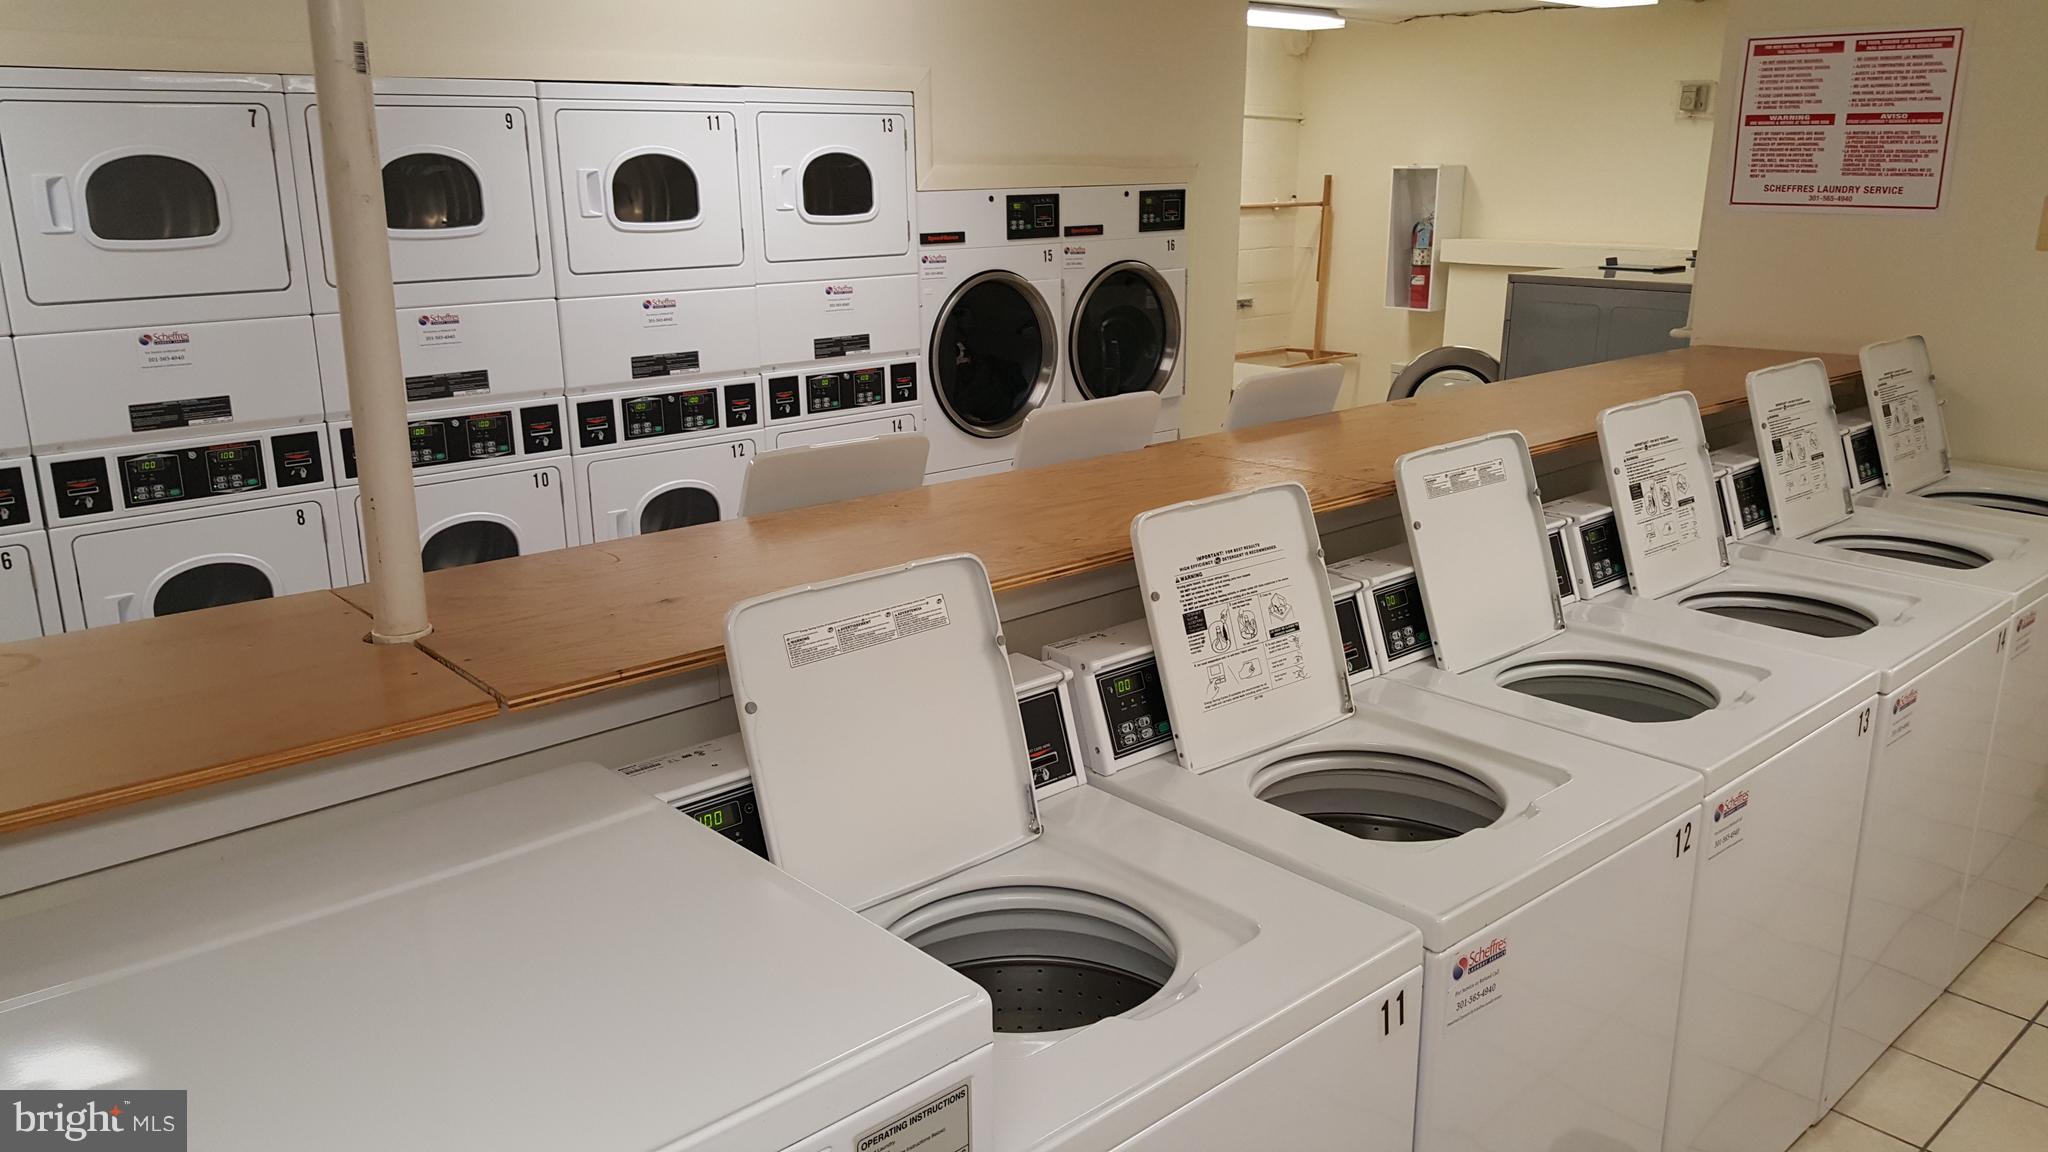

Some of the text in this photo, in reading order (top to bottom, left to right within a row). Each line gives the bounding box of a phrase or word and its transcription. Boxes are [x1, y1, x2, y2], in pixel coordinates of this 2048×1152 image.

[248, 108, 257, 128] 7
[504, 113, 514, 130] 9
[706, 115, 721, 132] 11
[880, 117, 895, 133] 13
[1764, 184, 1814, 192] SCHEFFRES
[1863, 186, 1904, 194] SERVICE
[1166, 240, 1176, 252] 16
[1043, 249, 1053, 263] 15
[891, 419, 903, 433] 14
[220, 451, 234, 459] 100
[731, 443, 745, 459] 12
[533, 472, 550, 489] 10
[297, 509, 306, 526] 8
[1, 552, 12, 570] 6
[1191, 560, 1213, 569] EFFICIENCY
[1180, 572, 1203, 581] WARNING
[1997, 628, 2006, 653] 14
[1858, 707, 1870, 737] 13
[1676, 822, 1691, 858] 12
[1469, 938, 1507, 967] Scheffres
[1381, 989, 1405, 1036] 11
[861, 1090, 966, 1151] OPERATING INSTRUCTIONS
